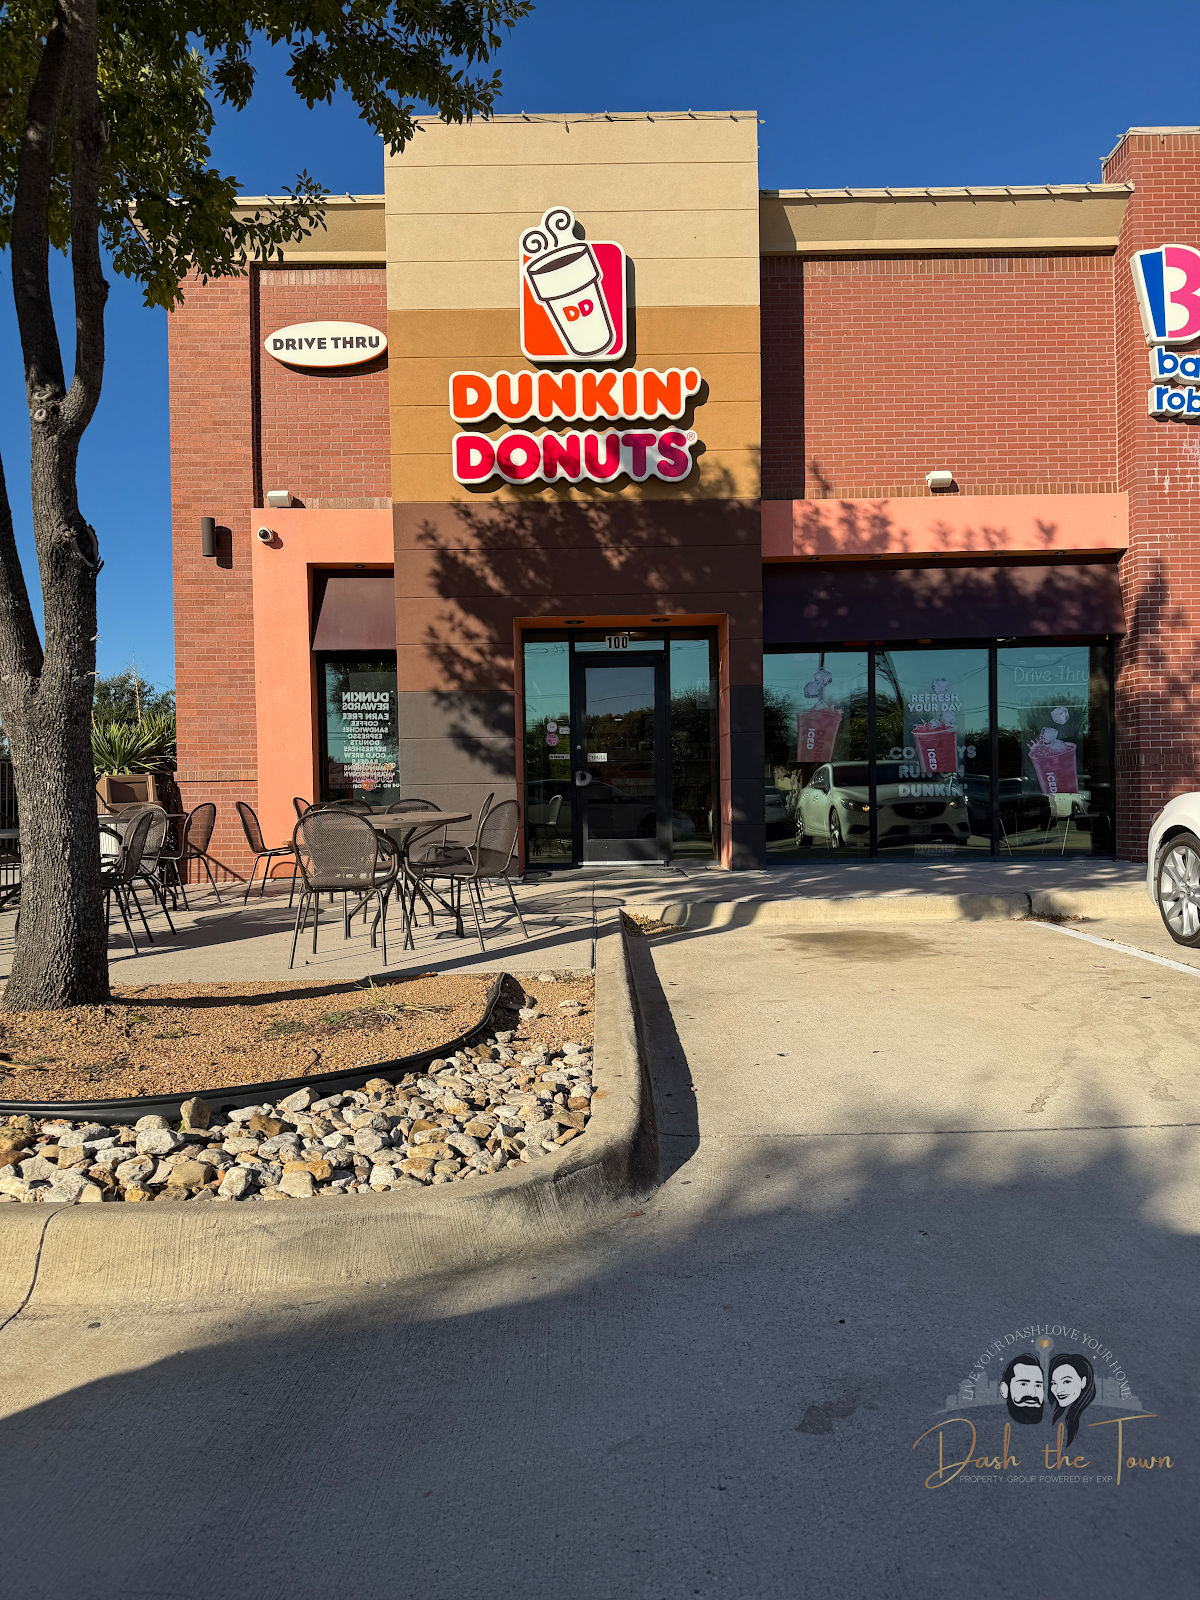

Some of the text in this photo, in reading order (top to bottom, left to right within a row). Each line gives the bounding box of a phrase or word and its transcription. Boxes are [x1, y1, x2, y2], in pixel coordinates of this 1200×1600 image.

[563, 299, 594, 322] DD
[272, 335, 380, 351] DRIVE THRU
[1157, 347, 1200, 378] ba
[452, 368, 698, 419] DUNKIN'
[607, 636, 628, 649] 100
[908, 703, 962, 712] YOUR DAY
[911, 694, 958, 703] REFRESH
[806, 728, 816, 750] ICED
[926, 748, 938, 771] ICED
[898, 783, 968, 797] DUNKIN'
[1045, 772, 1058, 793] ICED
